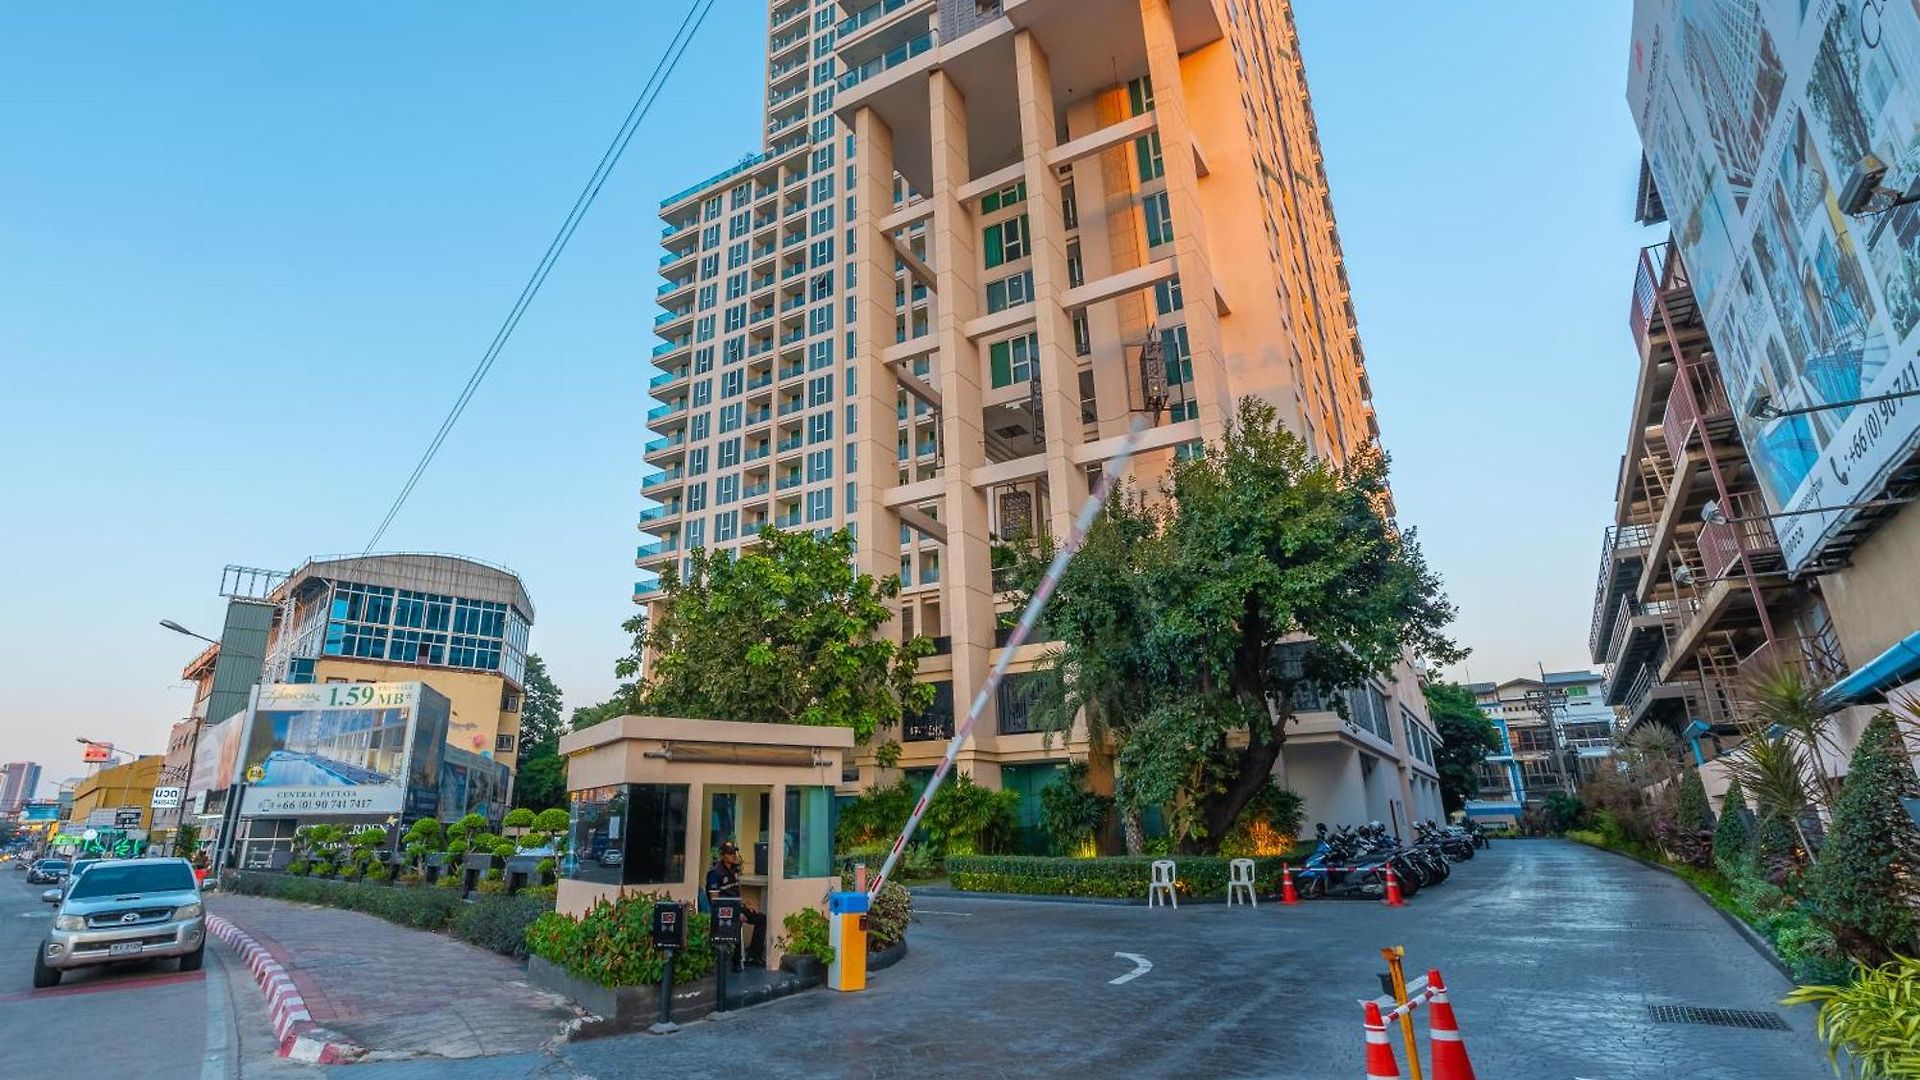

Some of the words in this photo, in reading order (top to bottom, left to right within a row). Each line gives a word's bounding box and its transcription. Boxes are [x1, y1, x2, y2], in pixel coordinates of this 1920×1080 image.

[330, 685, 375, 706] 1.59
[276, 791, 317, 799] CENTRAL
[320, 790, 357, 798] PATTAYA
[315, 799, 328, 809] 90
[331, 799, 347, 809] 741
[350, 799, 373, 809] 7417
